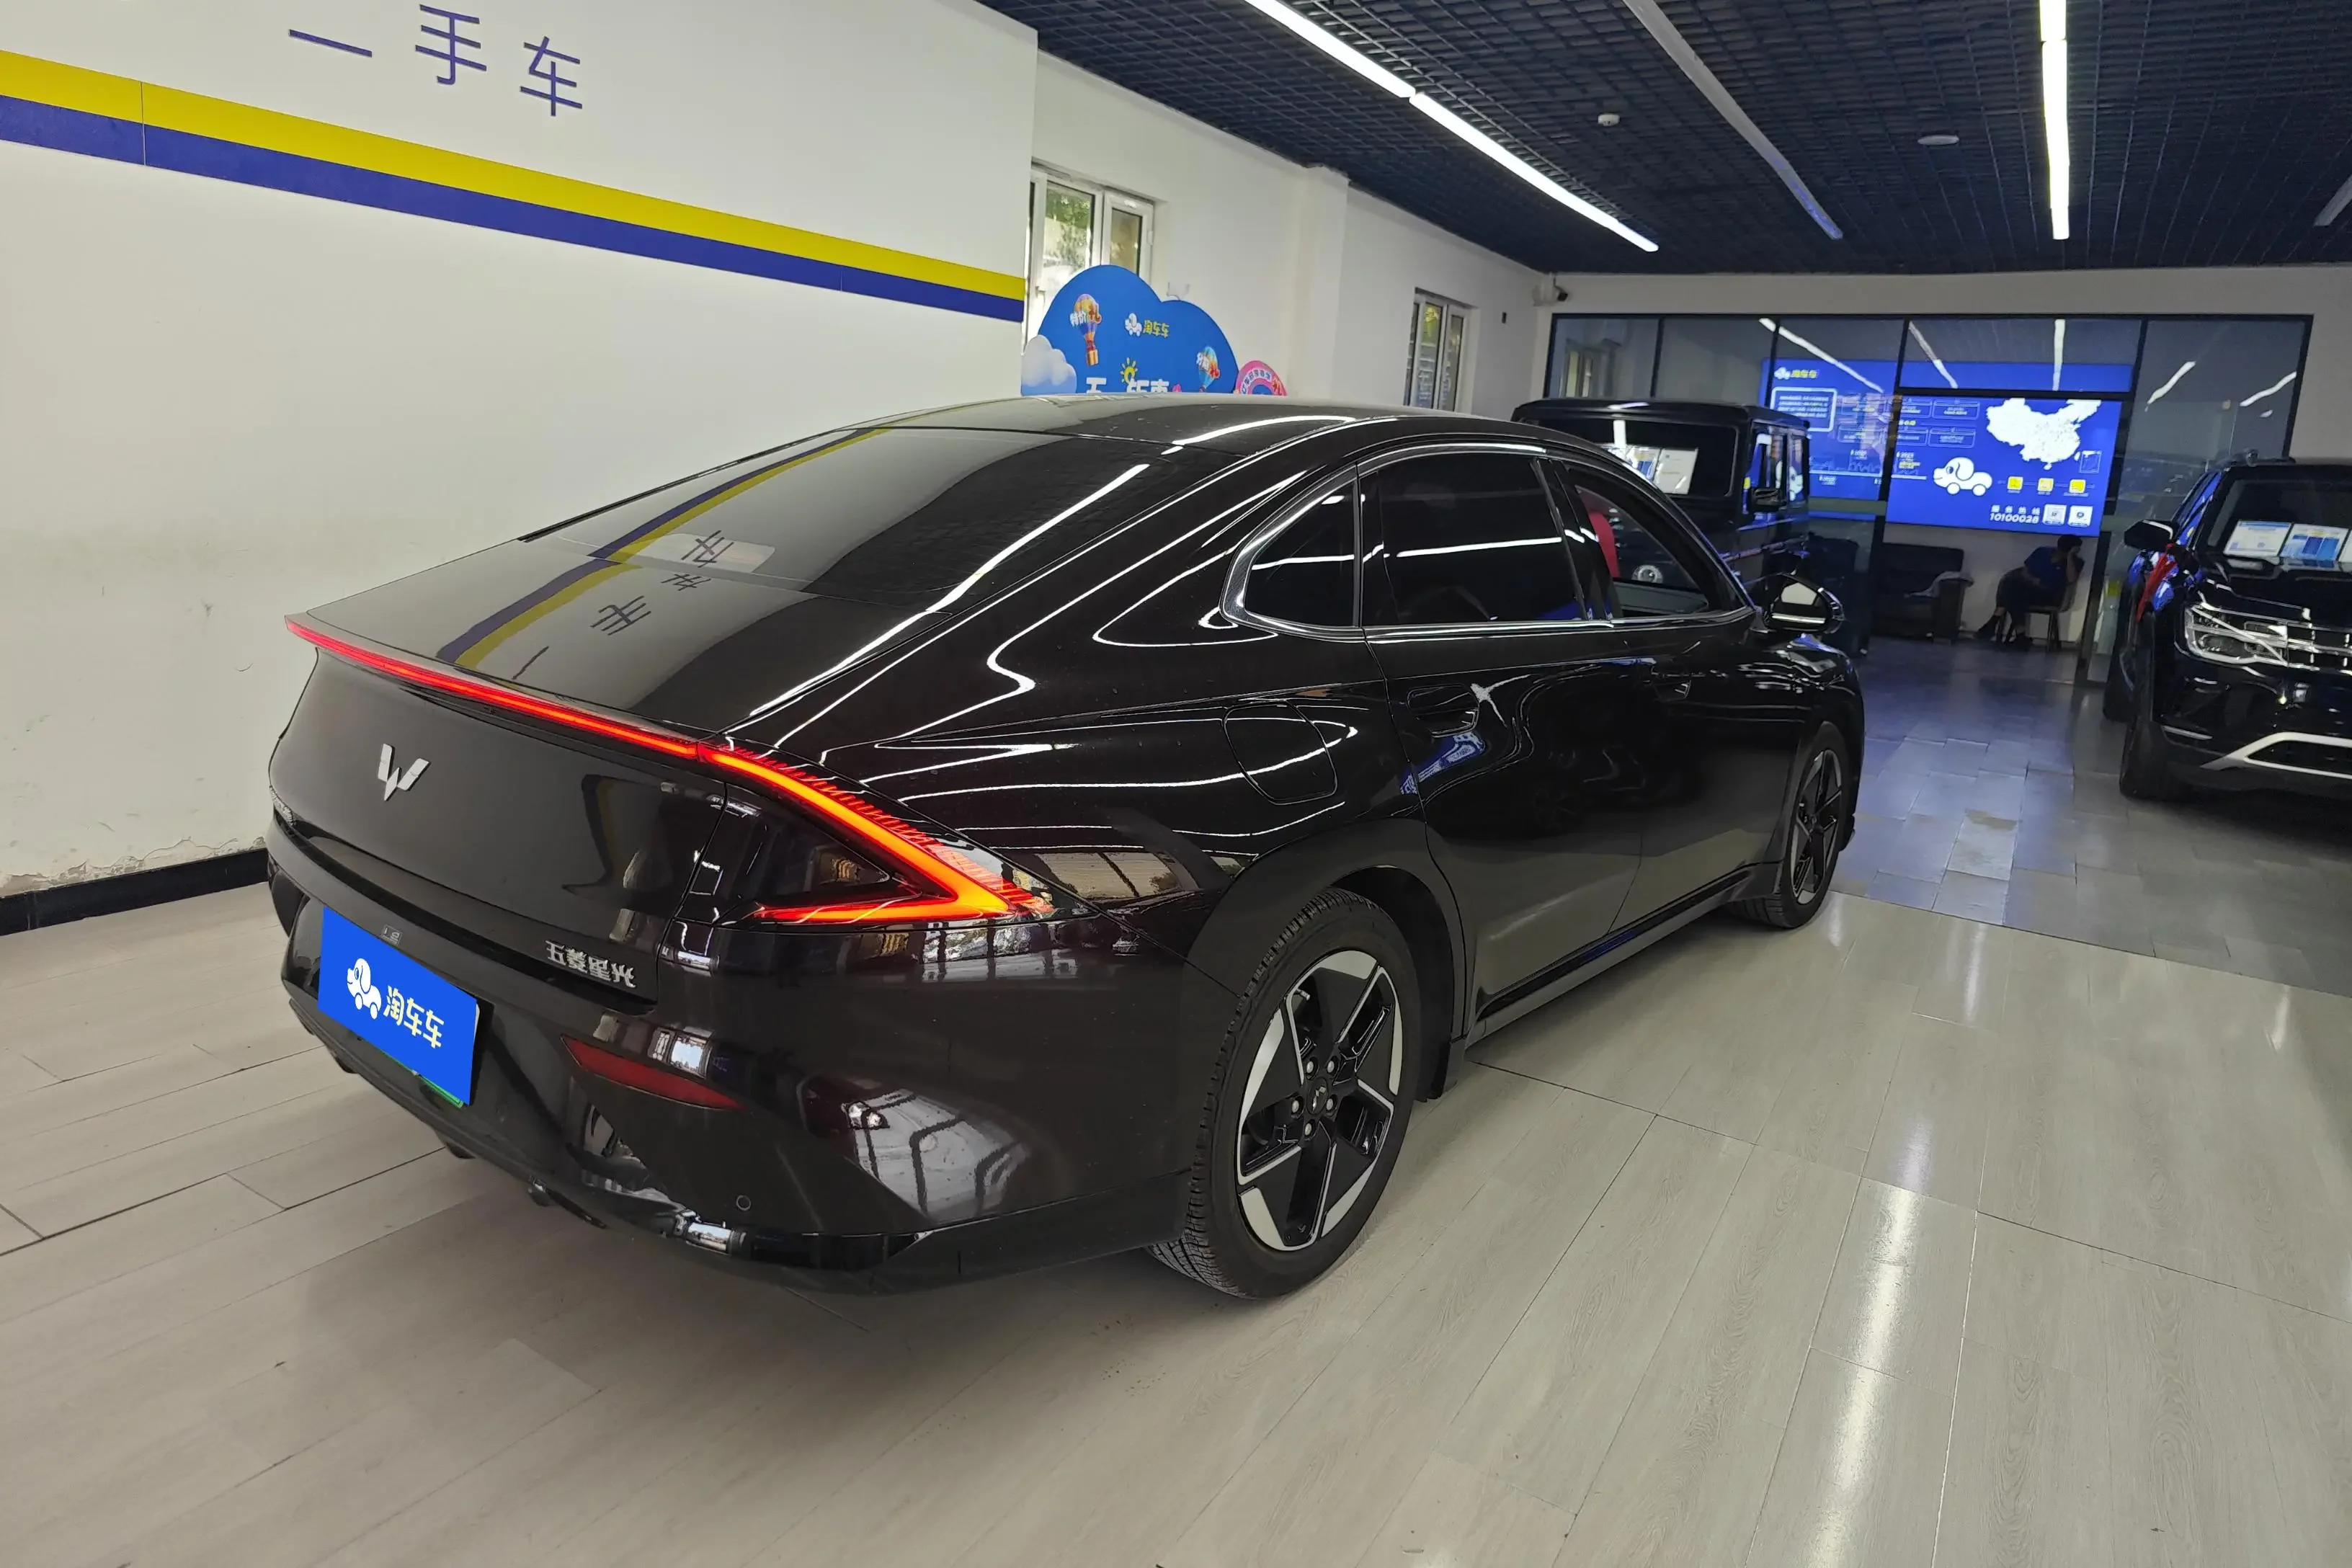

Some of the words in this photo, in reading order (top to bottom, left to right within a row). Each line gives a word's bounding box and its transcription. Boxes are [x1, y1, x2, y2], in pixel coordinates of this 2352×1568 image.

[1143, 319, 1170, 338] 淘车车
[545, 940, 636, 988] 五菱星光
